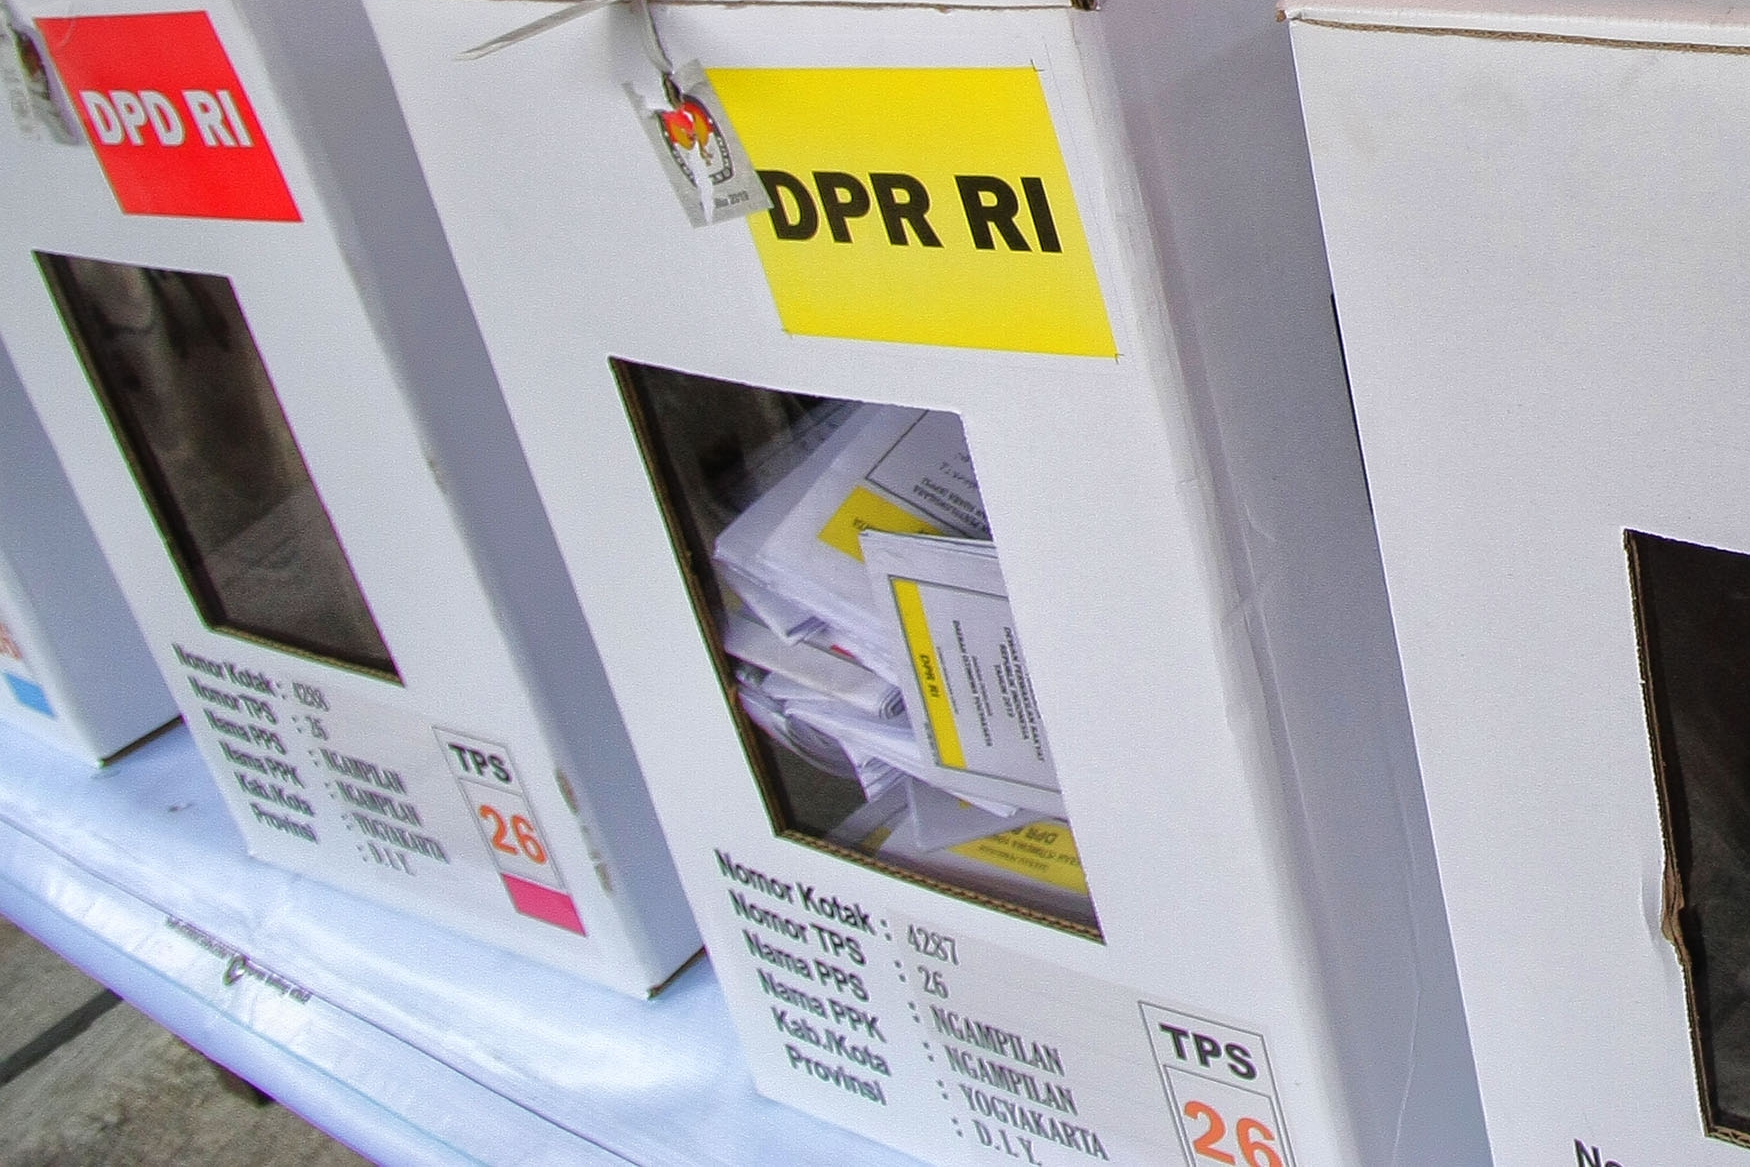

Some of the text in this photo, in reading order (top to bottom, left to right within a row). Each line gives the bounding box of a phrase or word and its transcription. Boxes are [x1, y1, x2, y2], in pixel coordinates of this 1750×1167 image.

[79, 90, 254, 148] DPD RI
[757, 170, 1062, 253] DPR RI
[238, 693, 278, 725] TPS
[448, 743, 512, 783] TPS
[479, 804, 547, 865] 26
[714, 848, 794, 904] Nomor
[796, 882, 876, 934] Kotak
[907, 924, 959, 966] 4287
[728, 888, 808, 943] Nomor
[809, 922, 867, 966] TPS
[917, 965, 949, 999] 26
[742, 929, 815, 981] Nama
[813, 958, 870, 1002] PPS
[929, 1004, 1065, 1077] NGAMPILAN
[757, 968, 828, 1019] Nama
[828, 997, 887, 1043] PPK
[944, 1044, 1078, 1116] NGAMPILAN
[785, 1043, 887, 1106] Provinsi
[1158, 1022, 1258, 1080] TPS
[959, 1083, 1110, 1162] YOGYAKARTA
[1184, 1100, 1283, 1167] 26
